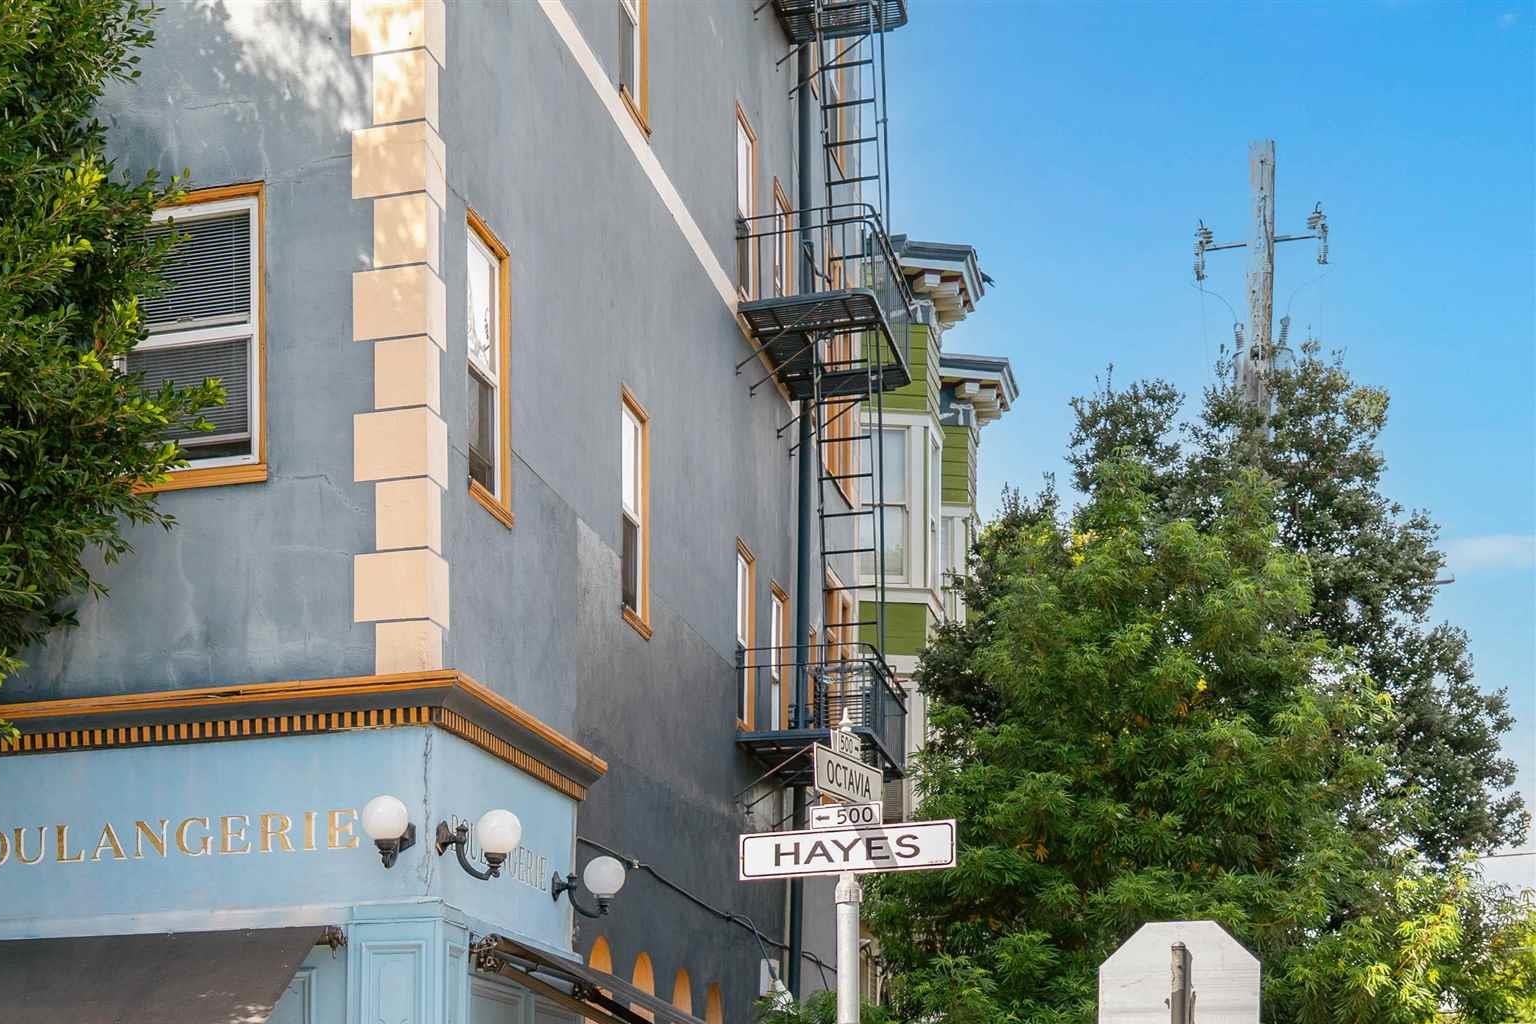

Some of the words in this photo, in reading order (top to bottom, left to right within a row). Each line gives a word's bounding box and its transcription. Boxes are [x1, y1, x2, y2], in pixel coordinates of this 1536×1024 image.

[840, 735, 854, 753] 500
[826, 759, 872, 800] OCTAVIA
[836, 806, 874, 825] 500
[774, 834, 921, 867] HAYES
